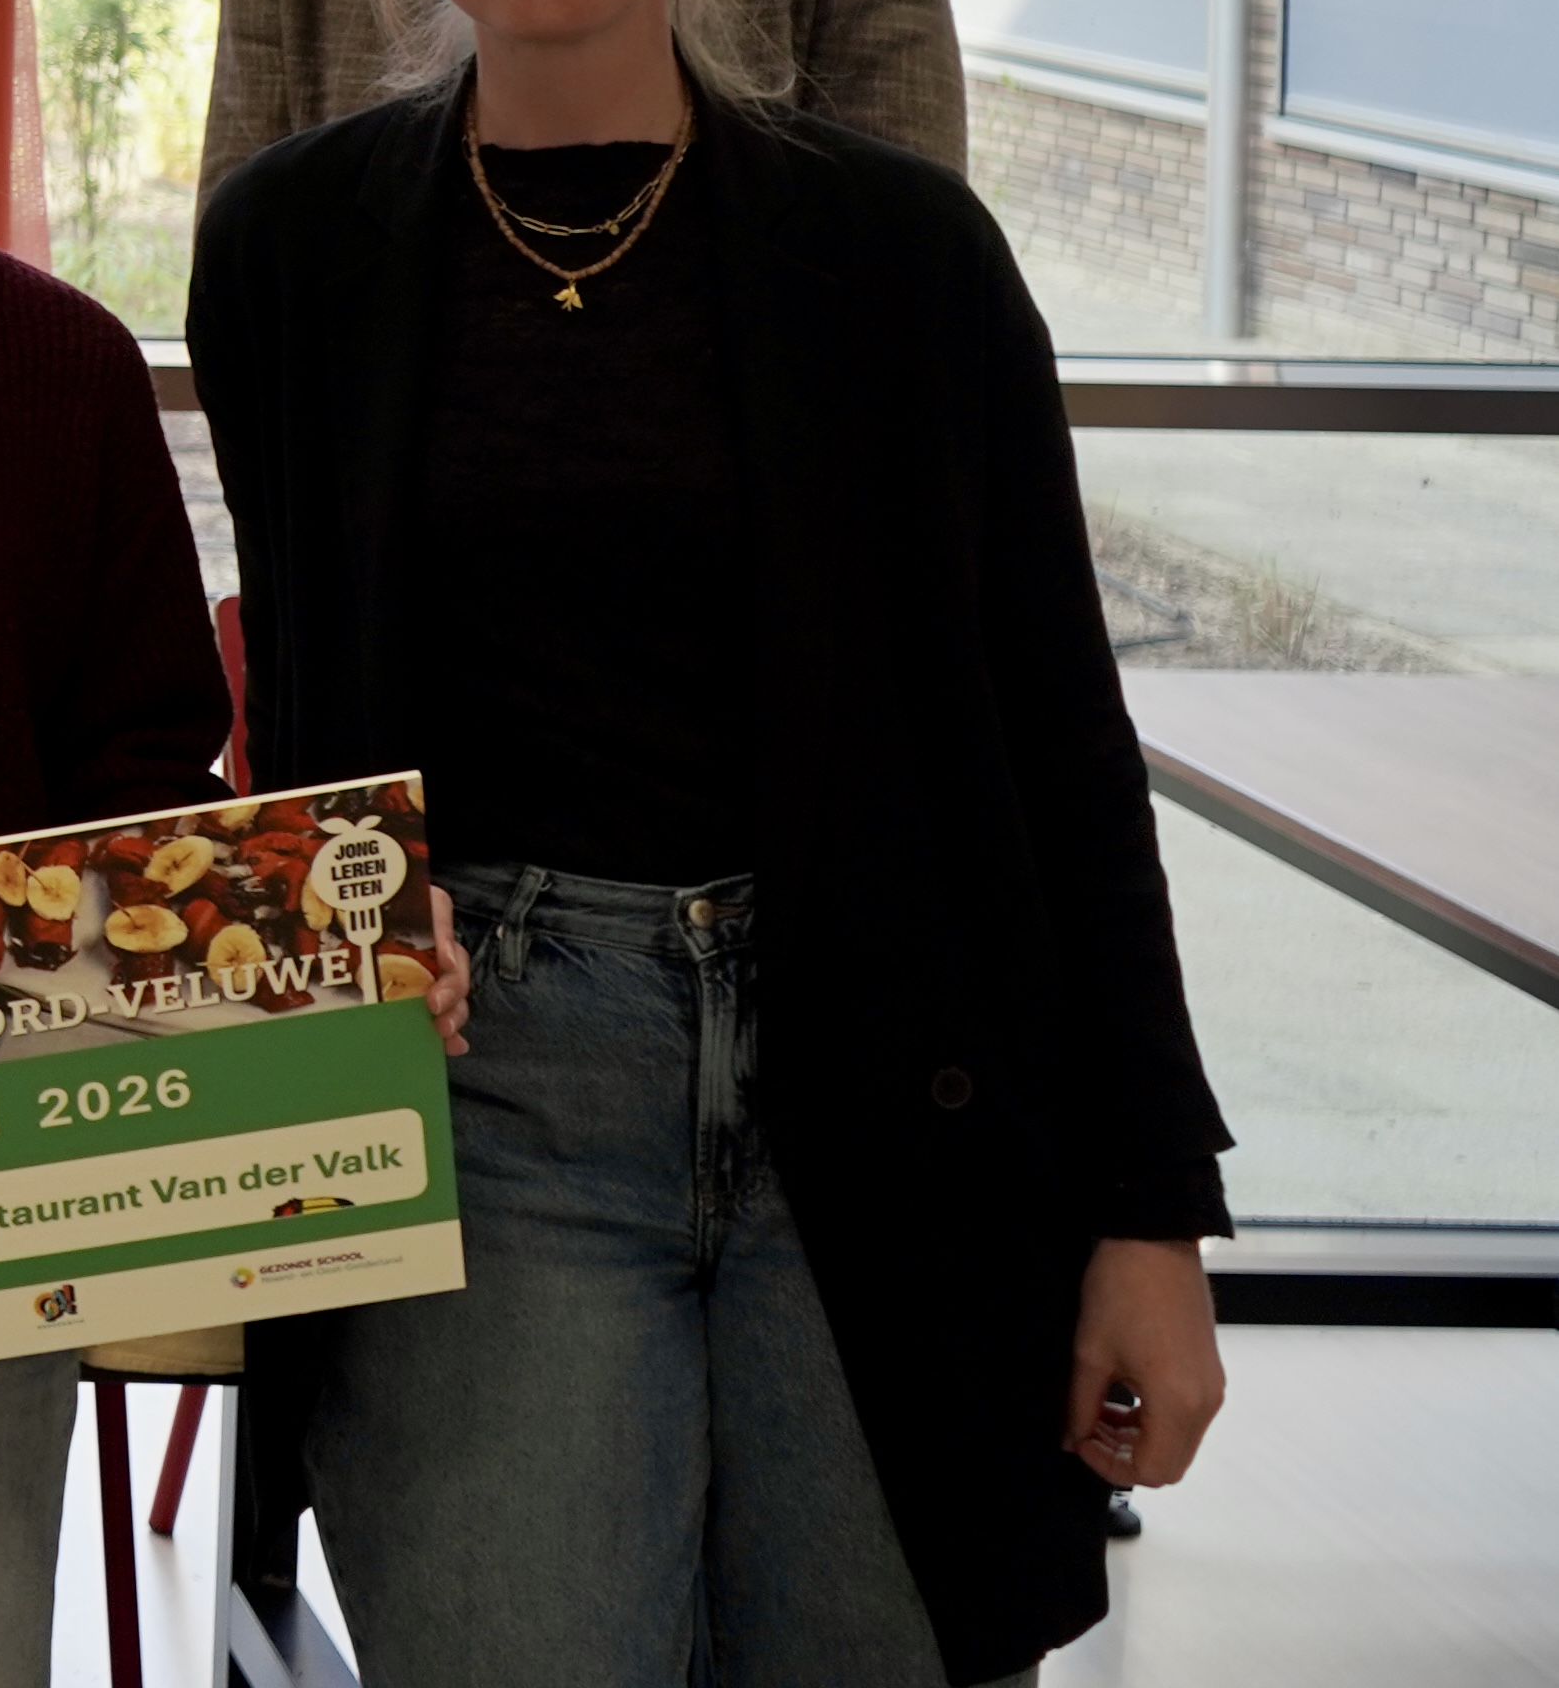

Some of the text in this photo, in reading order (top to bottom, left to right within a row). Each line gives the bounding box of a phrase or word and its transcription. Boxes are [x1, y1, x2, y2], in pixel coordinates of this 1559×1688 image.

[334, 840, 380, 861] JONG
[330, 859, 387, 882] LEREN
[338, 879, 383, 900] ETEN
[37, 1068, 192, 1130] 2026
[150, 1175, 227, 1203] Van
[238, 1161, 305, 1192] der
[313, 1143, 404, 1181] Valk
[259, 1252, 364, 1274] GEZONDE SCHOOL
